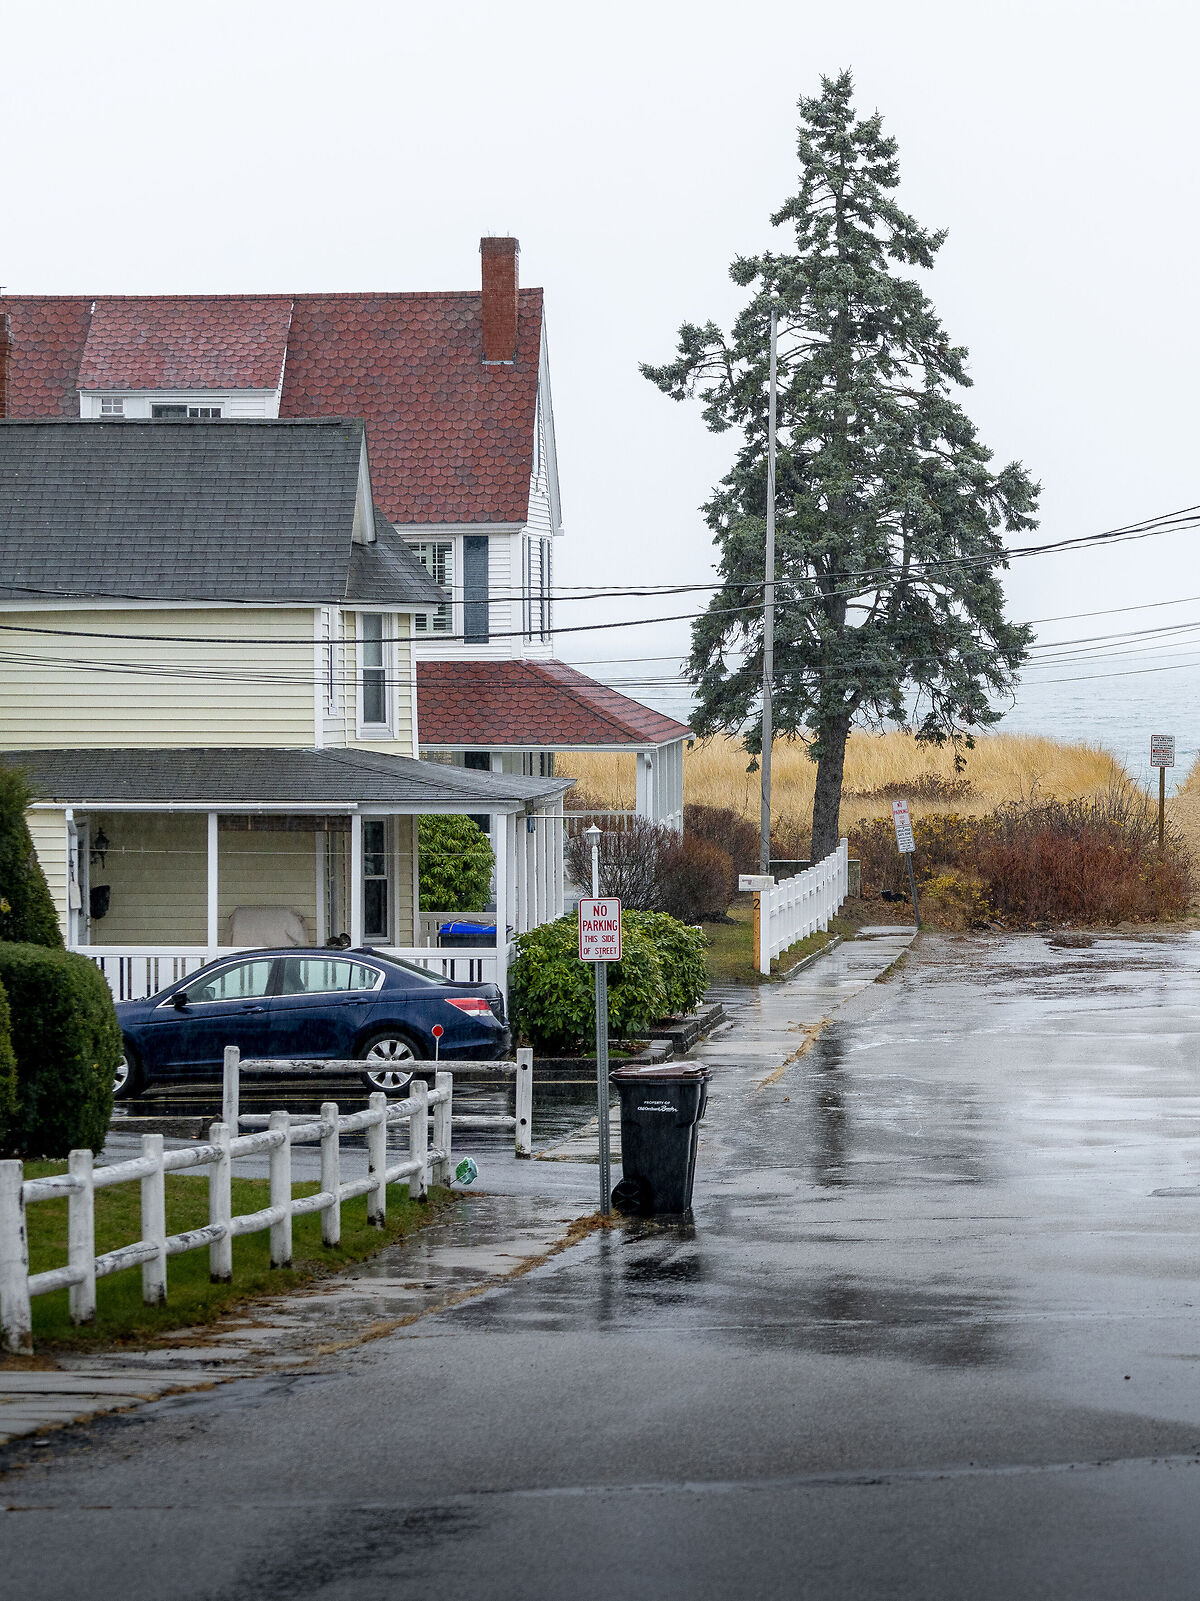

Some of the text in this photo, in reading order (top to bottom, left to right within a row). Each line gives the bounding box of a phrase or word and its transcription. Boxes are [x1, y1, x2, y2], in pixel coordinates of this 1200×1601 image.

[753, 898, 760, 910] 2
[593, 905, 607, 917] NO
[582, 920, 618, 931] PARKING
[585, 935, 615, 943] THIS SIDE
[583, 947, 617, 955] OF STREET
